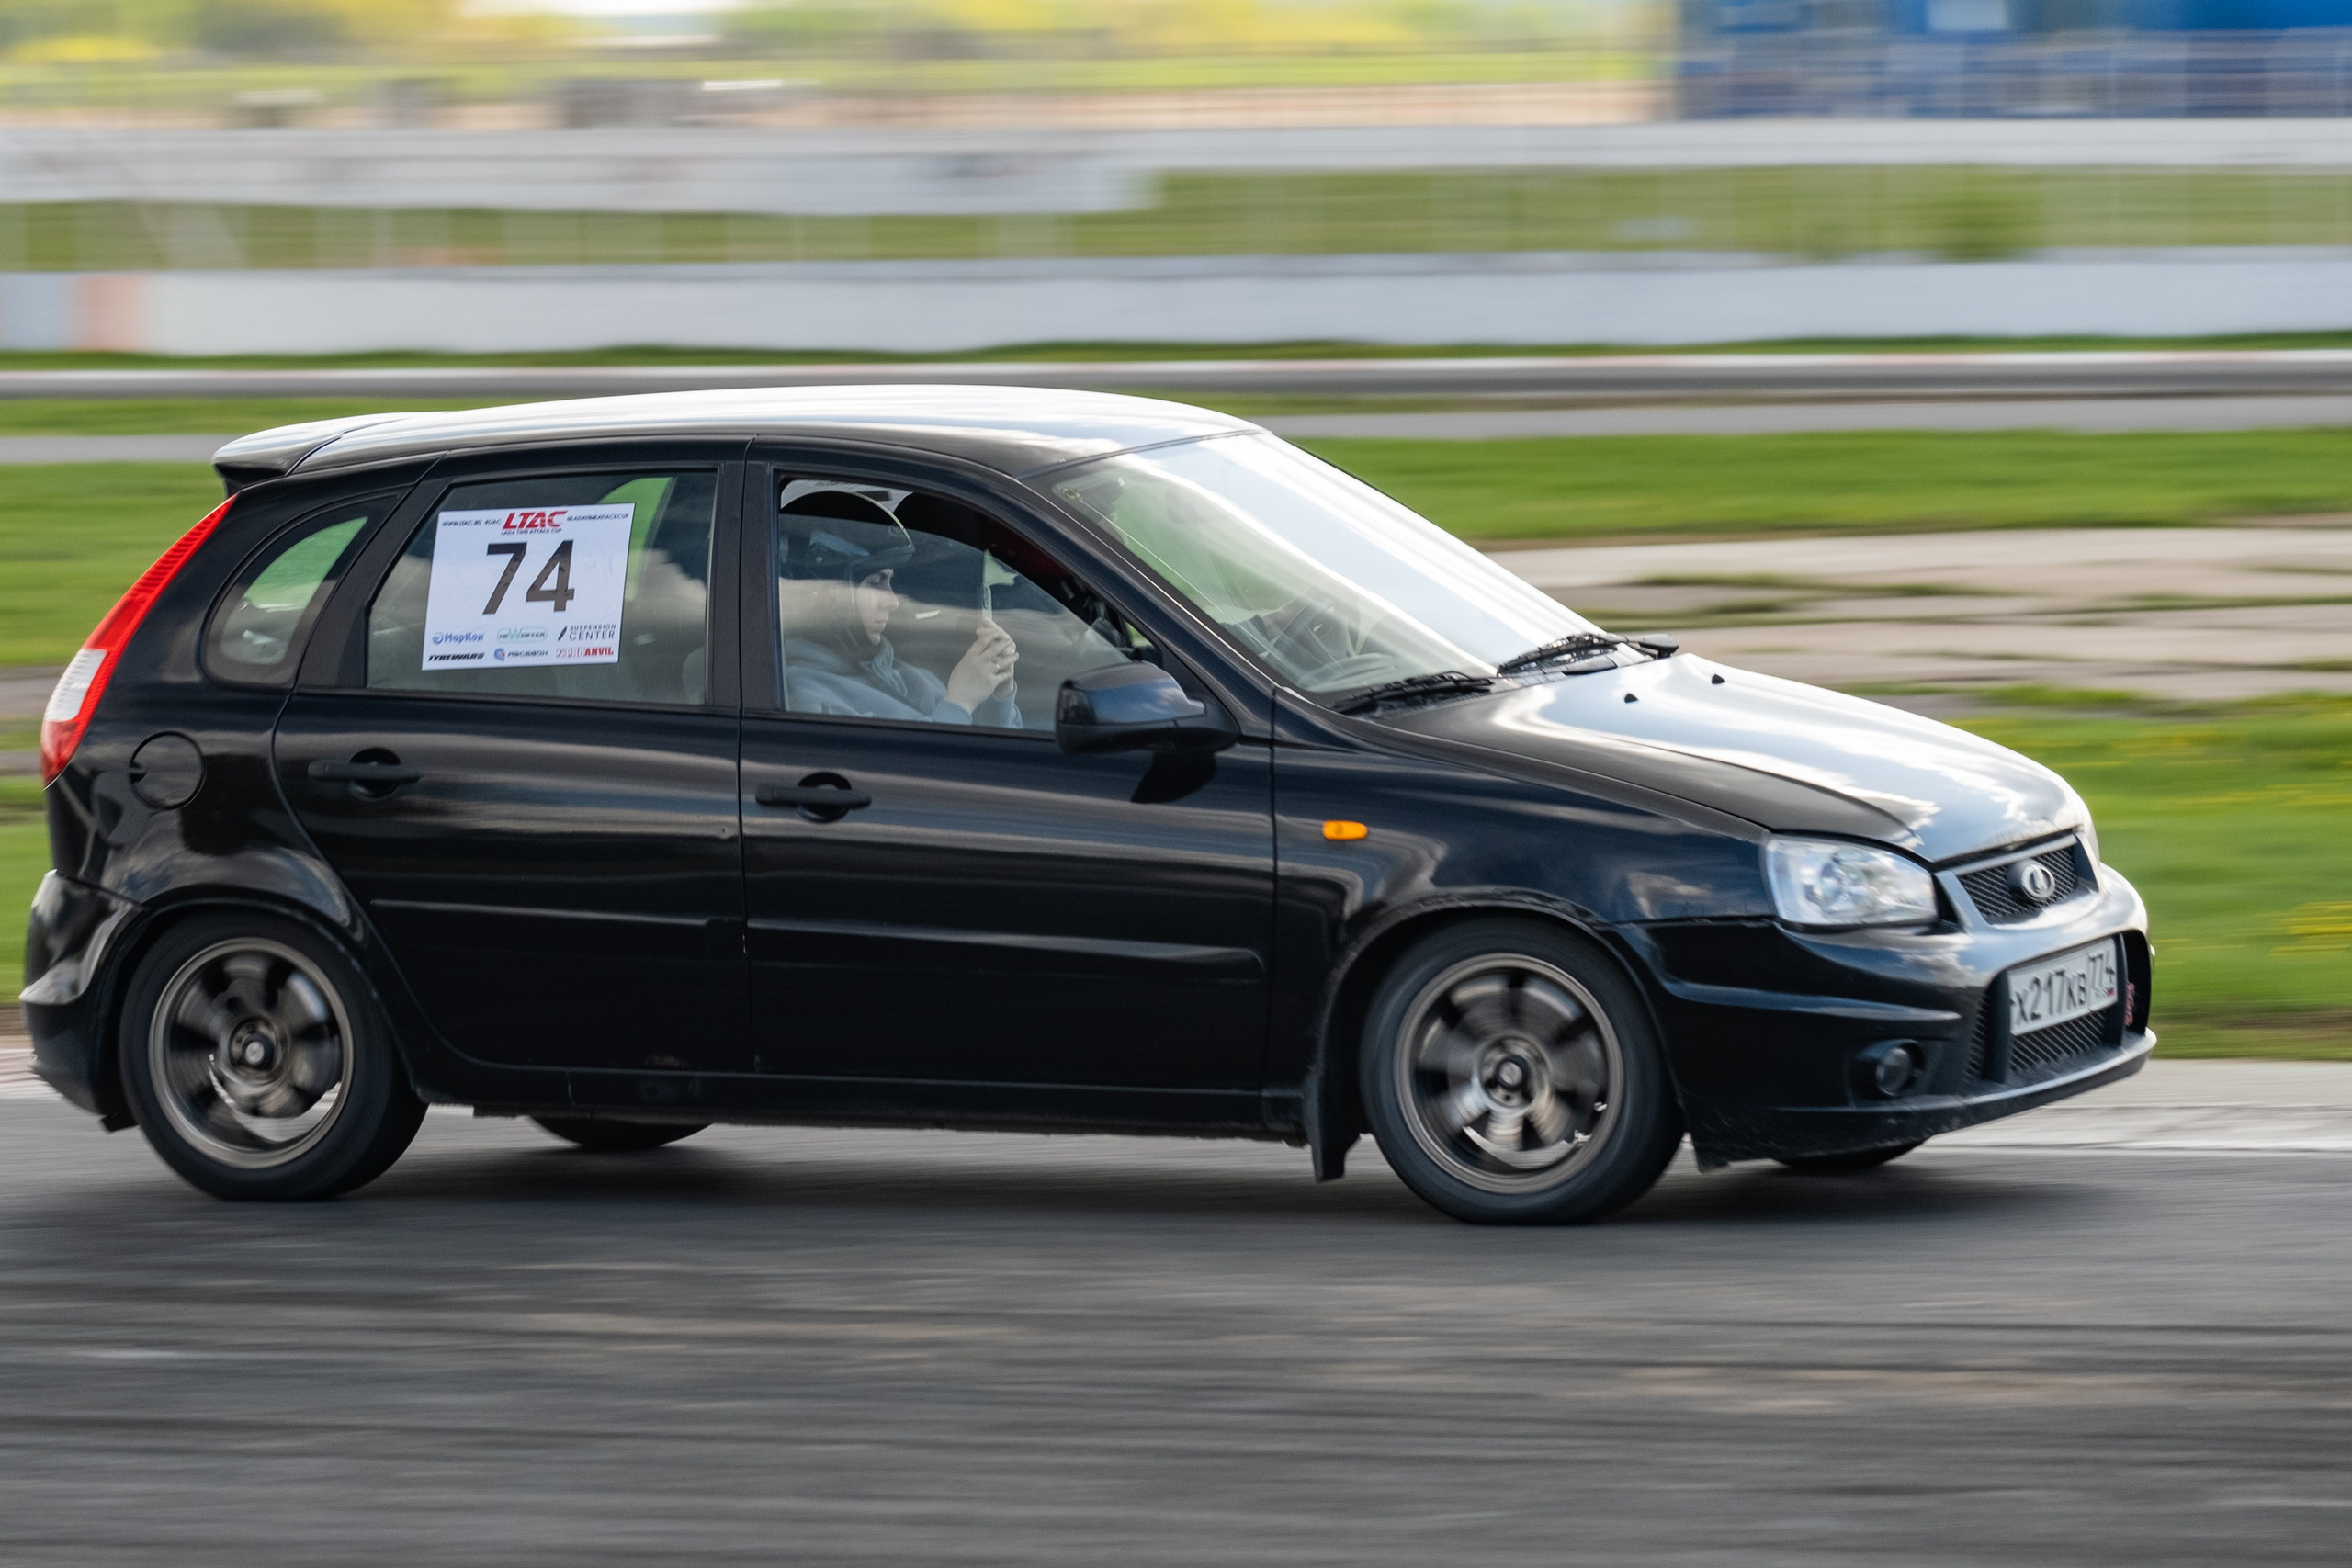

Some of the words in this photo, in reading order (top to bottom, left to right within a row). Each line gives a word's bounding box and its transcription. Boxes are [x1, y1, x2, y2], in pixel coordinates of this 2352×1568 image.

[503, 511, 568, 529] LTAC
[482, 540, 575, 615] 74
[570, 630, 615, 641] CENTER
